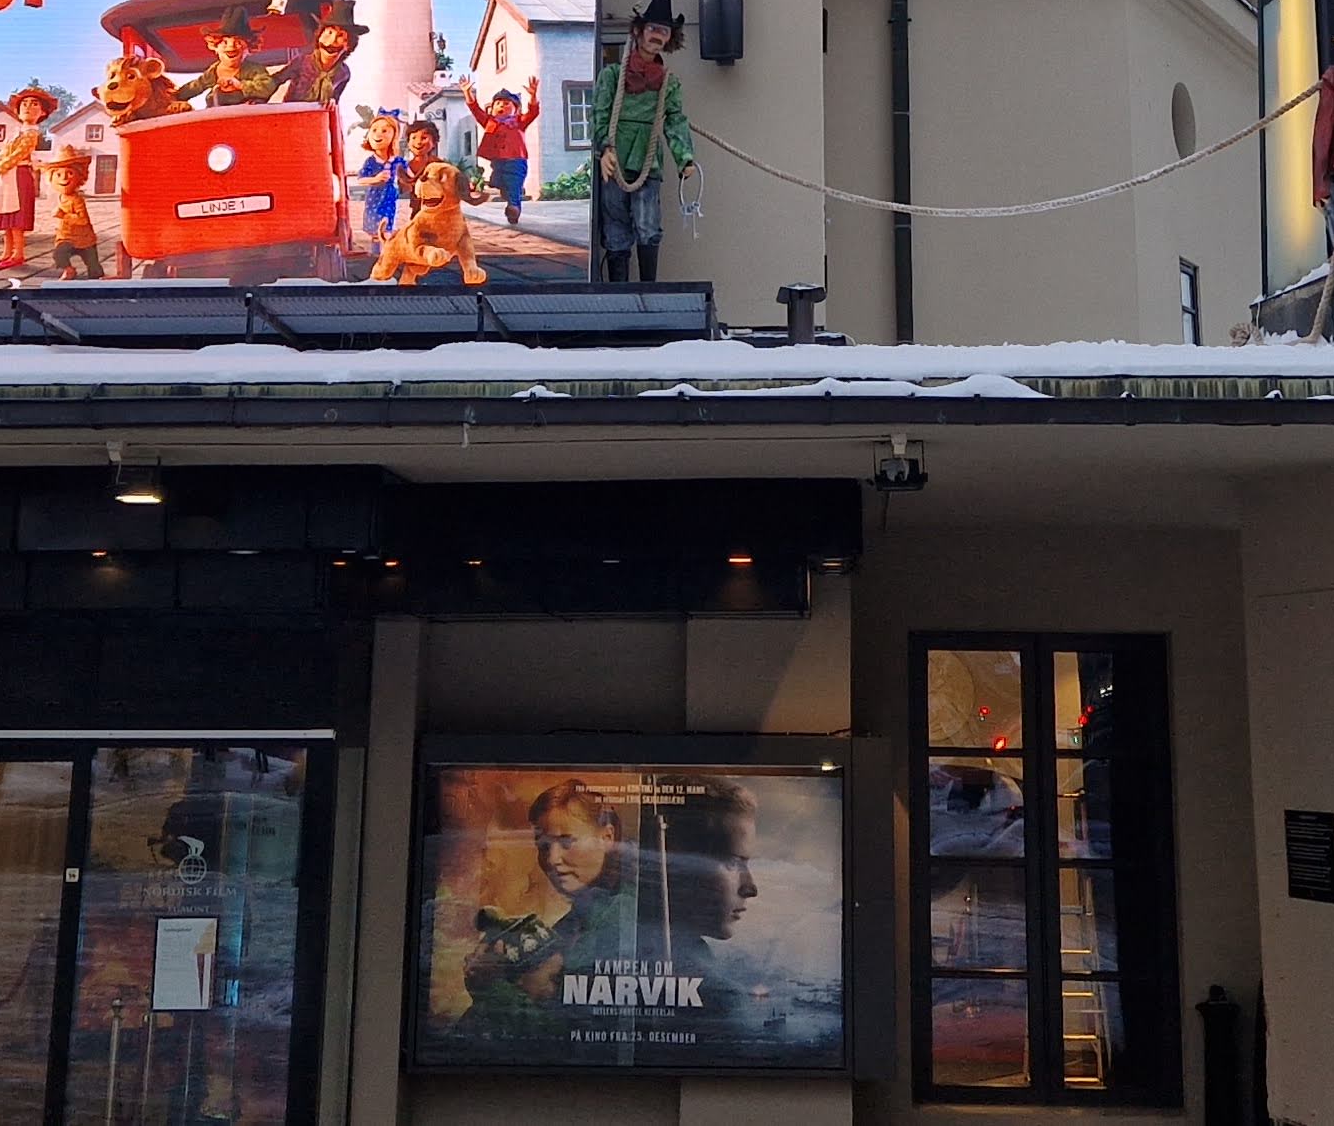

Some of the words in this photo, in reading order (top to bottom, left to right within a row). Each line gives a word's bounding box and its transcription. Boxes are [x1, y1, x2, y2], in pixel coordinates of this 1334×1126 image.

[201, 200, 236, 214] LINJE
[239, 200, 246, 210] 1
[143, 887, 202, 896] NORDISK
[205, 886, 237, 897] FILM
[594, 959, 648, 975] KAMPEN
[655, 961, 673, 976] OM
[562, 974, 704, 1007] NARVIK
[570, 1028, 583, 1042] PÅ
[585, 1031, 606, 1042] KINO
[610, 1031, 628, 1042] FRA
[649, 1031, 696, 1044] DESEMBER
